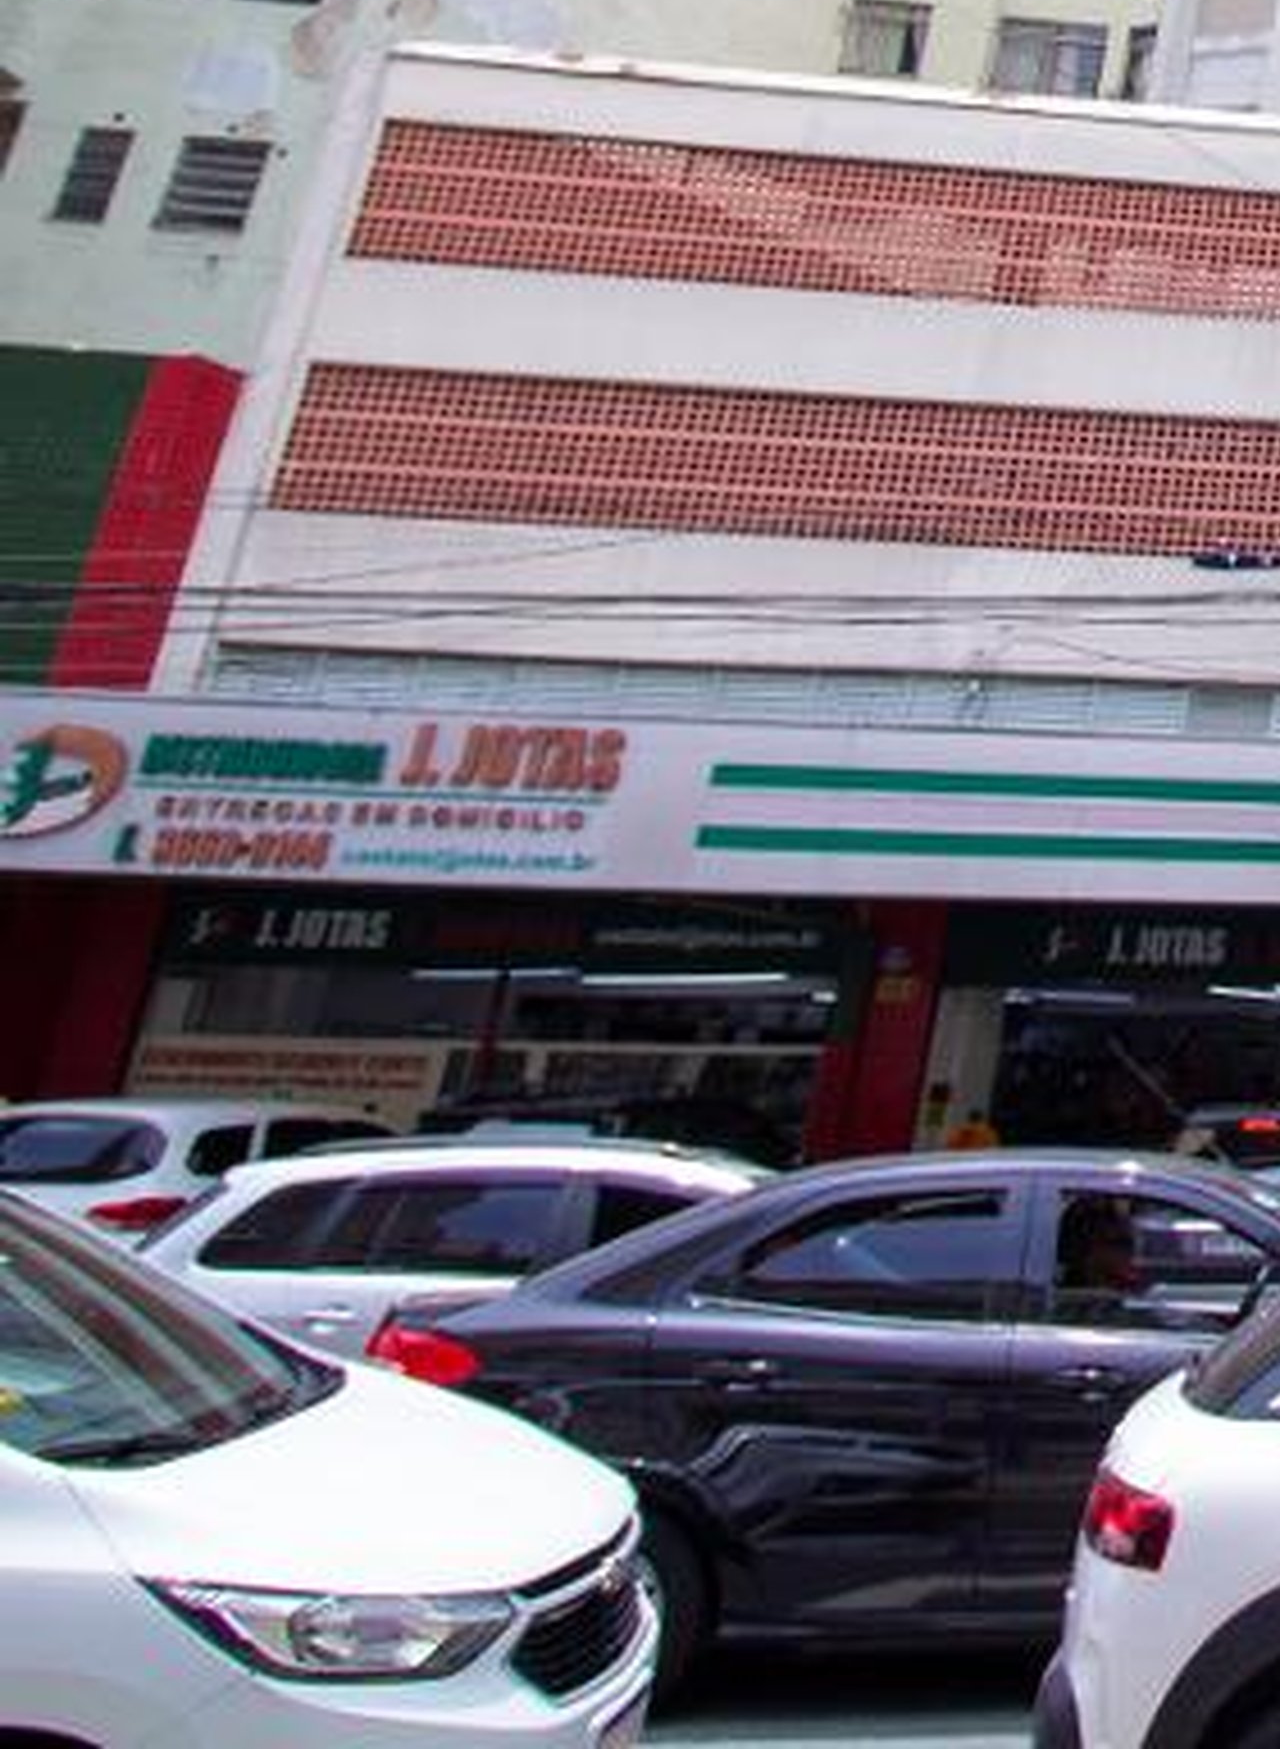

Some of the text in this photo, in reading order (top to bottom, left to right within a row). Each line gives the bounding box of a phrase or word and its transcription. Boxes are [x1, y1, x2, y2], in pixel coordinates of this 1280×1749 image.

[400, 723, 440, 787] J.
[448, 724, 627, 792] JOTAS
[283, 908, 392, 950] JOTAS
[1133, 927, 1230, 966] JOTAS
